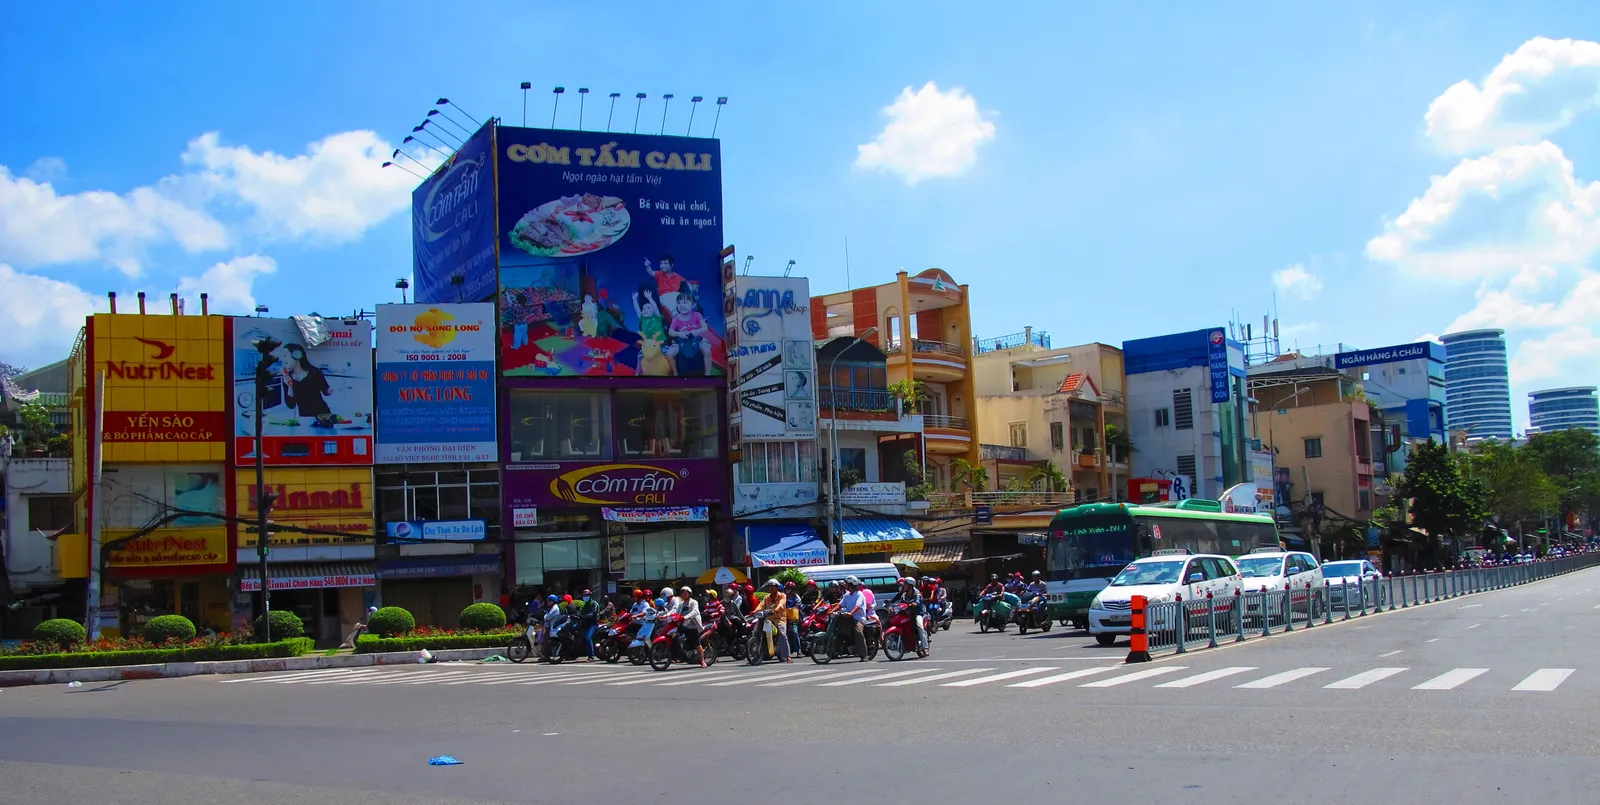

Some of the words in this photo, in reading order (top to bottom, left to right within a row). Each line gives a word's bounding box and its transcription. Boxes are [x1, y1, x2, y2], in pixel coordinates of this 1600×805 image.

[507, 142, 571, 165] CƠM
[575, 141, 641, 169] TẤM
[645, 151, 713, 171] CALI
[562, 170, 584, 183] Ngọt
[586, 172, 607, 184] ngào
[610, 172, 624, 184] hạt
[626, 172, 643, 184] tấm
[646, 174, 662, 185] Việt
[639, 198, 651, 209] Bé
[655, 199, 670, 210] vừa
[674, 201, 686, 211] vui
[690, 200, 710, 212] chơi,
[455, 200, 479, 228] CALI
[660, 216, 675, 226] vừa
[679, 217, 690, 226] ăn
[693, 216, 716, 228] ngon!
[389, 324, 407, 332] ĐÒI
[410, 325, 423, 333] NỢ
[455, 324, 480, 332] LONG
[448, 353, 467, 361] 2008
[1341, 354, 1365, 364] NGÂN
[1366, 352, 1390, 361] HÀNG
[1392, 349, 1398, 358] Á
[1399, 346, 1423, 357] CHÂU
[105, 360, 215, 380] NutriNest
[399, 386, 433, 402] SONG
[436, 386, 472, 402] LONG
[127, 412, 159, 427] YẾN
[162, 413, 194, 427] SÀO
[104, 432, 112, 440] &
[165, 432, 188, 440] CAO
[190, 428, 212, 440] CẤP
[634, 494, 666, 504] CALI
[471, 525, 483, 534] Lịch
[267, 578, 292, 588] Rinnai
[358, 575, 362, 584] 2
